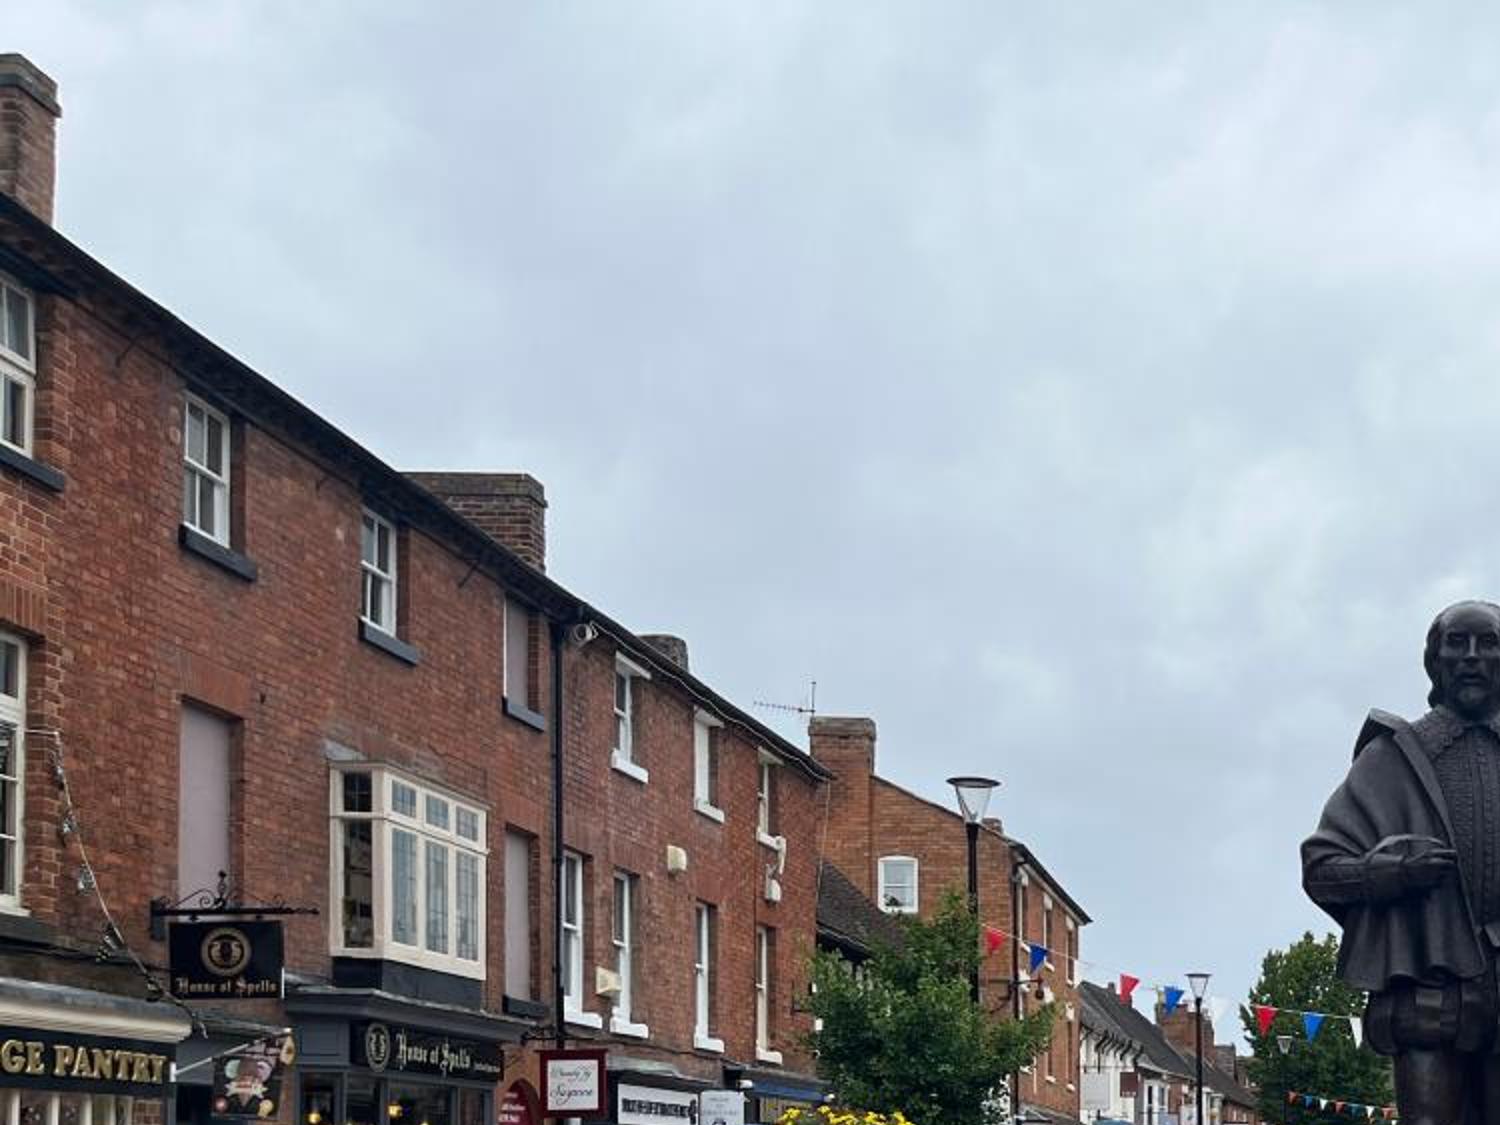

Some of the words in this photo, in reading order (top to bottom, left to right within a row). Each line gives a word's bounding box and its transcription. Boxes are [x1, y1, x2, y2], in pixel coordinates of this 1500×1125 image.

[176, 976, 216, 994] House
[219, 979, 231, 993] of
[235, 976, 277, 997] Spells
[54, 1044, 167, 1084] PANTRY
[395, 1028, 427, 1070] House
